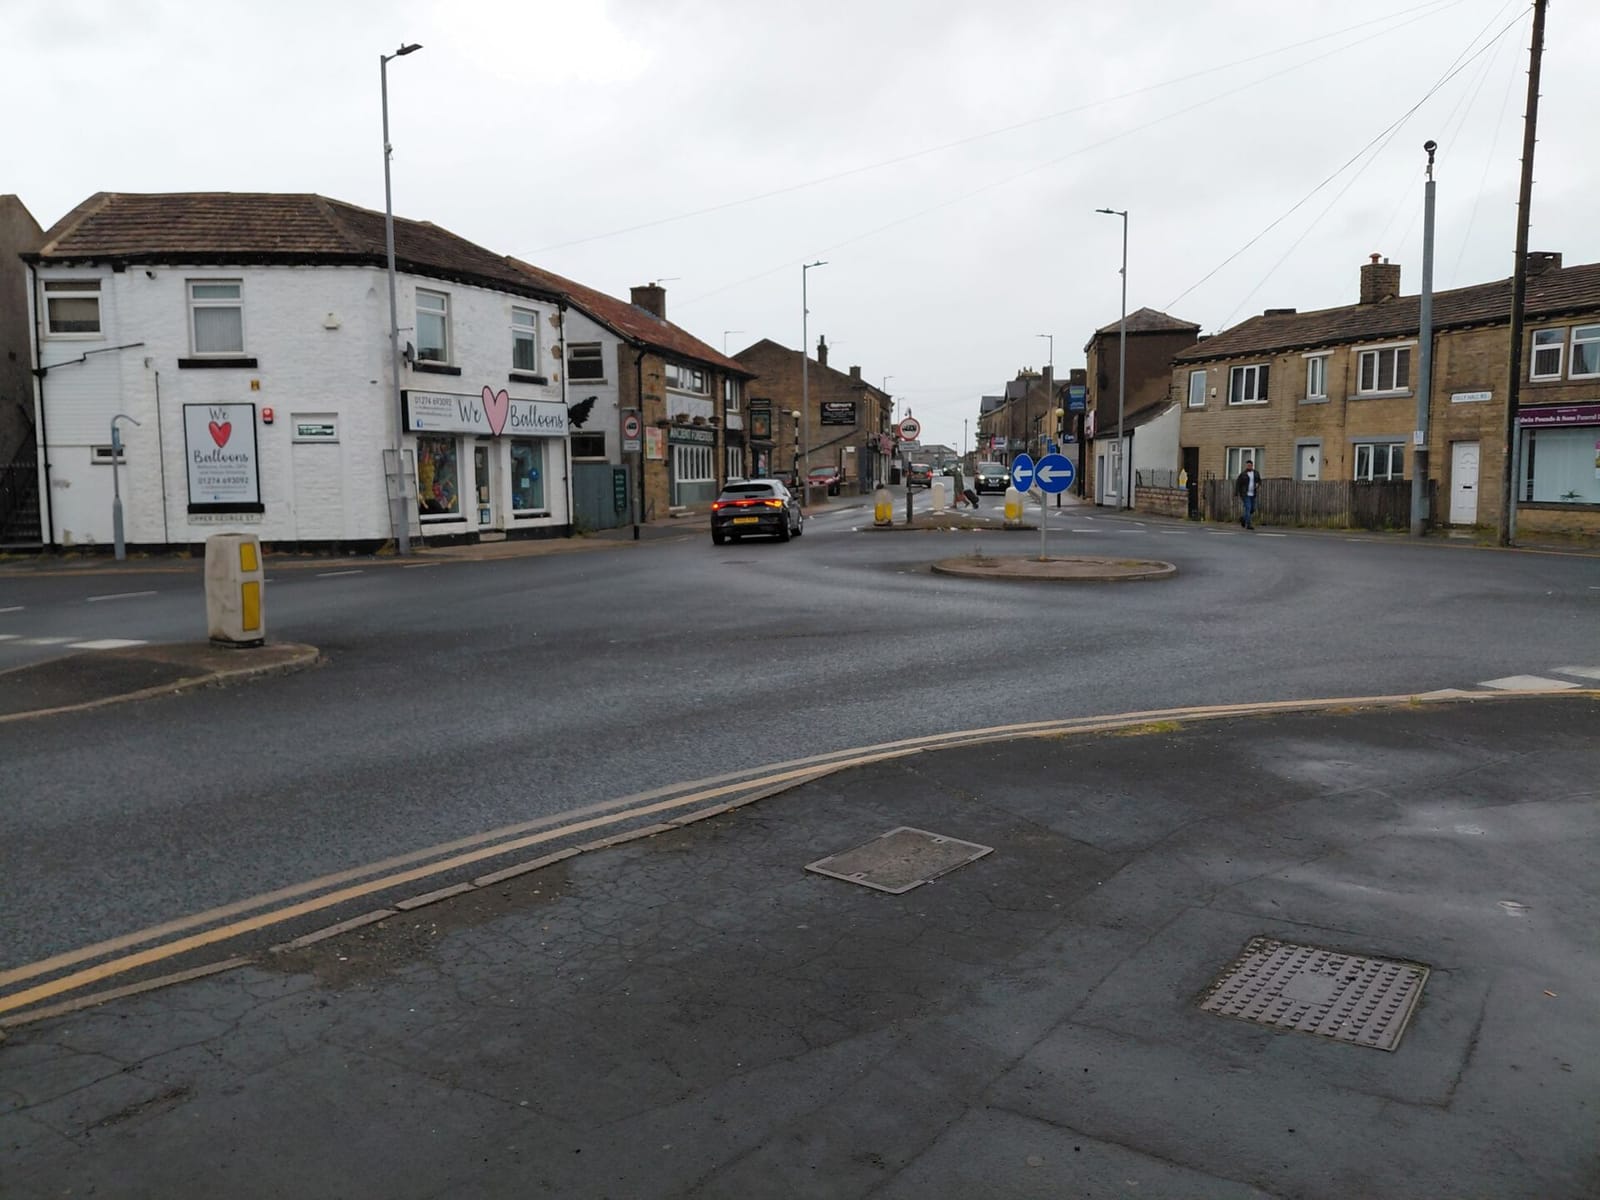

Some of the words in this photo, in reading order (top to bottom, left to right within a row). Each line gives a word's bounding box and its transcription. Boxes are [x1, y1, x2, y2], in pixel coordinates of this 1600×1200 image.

[209, 406, 230, 420] We
[458, 399, 482, 423] We
[510, 404, 564, 429] Balloons
[193, 449, 249, 463] Balloons
